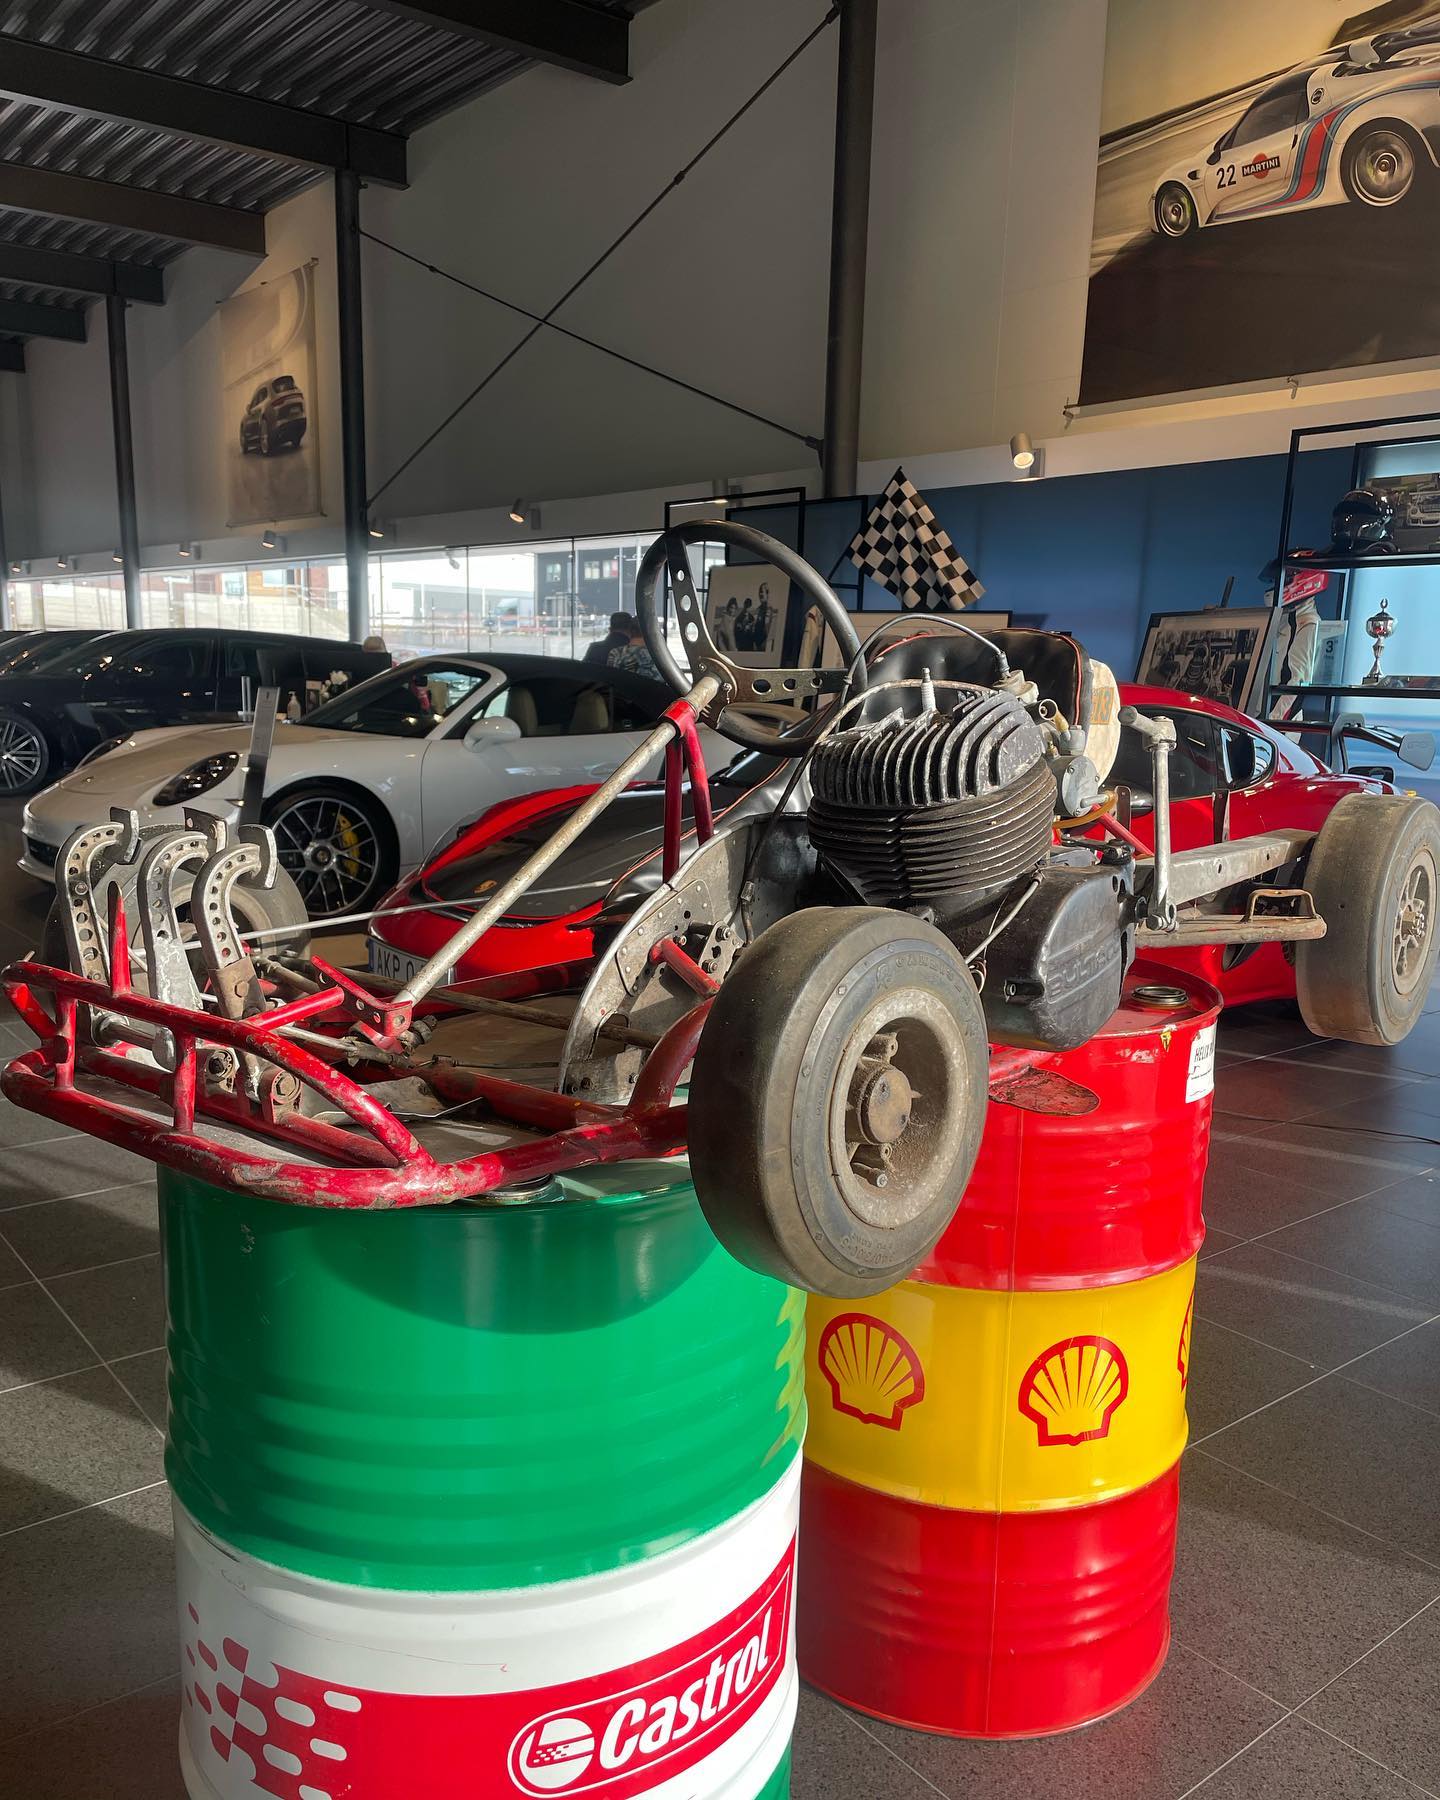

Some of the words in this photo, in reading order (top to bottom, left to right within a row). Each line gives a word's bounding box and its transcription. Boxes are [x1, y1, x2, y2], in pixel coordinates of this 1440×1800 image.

[1216, 164, 1236, 189] 22
[1243, 158, 1278, 175] MARTINI
[376, 947, 401, 979] AKP
[599, 1605, 773, 1770] Castrol
